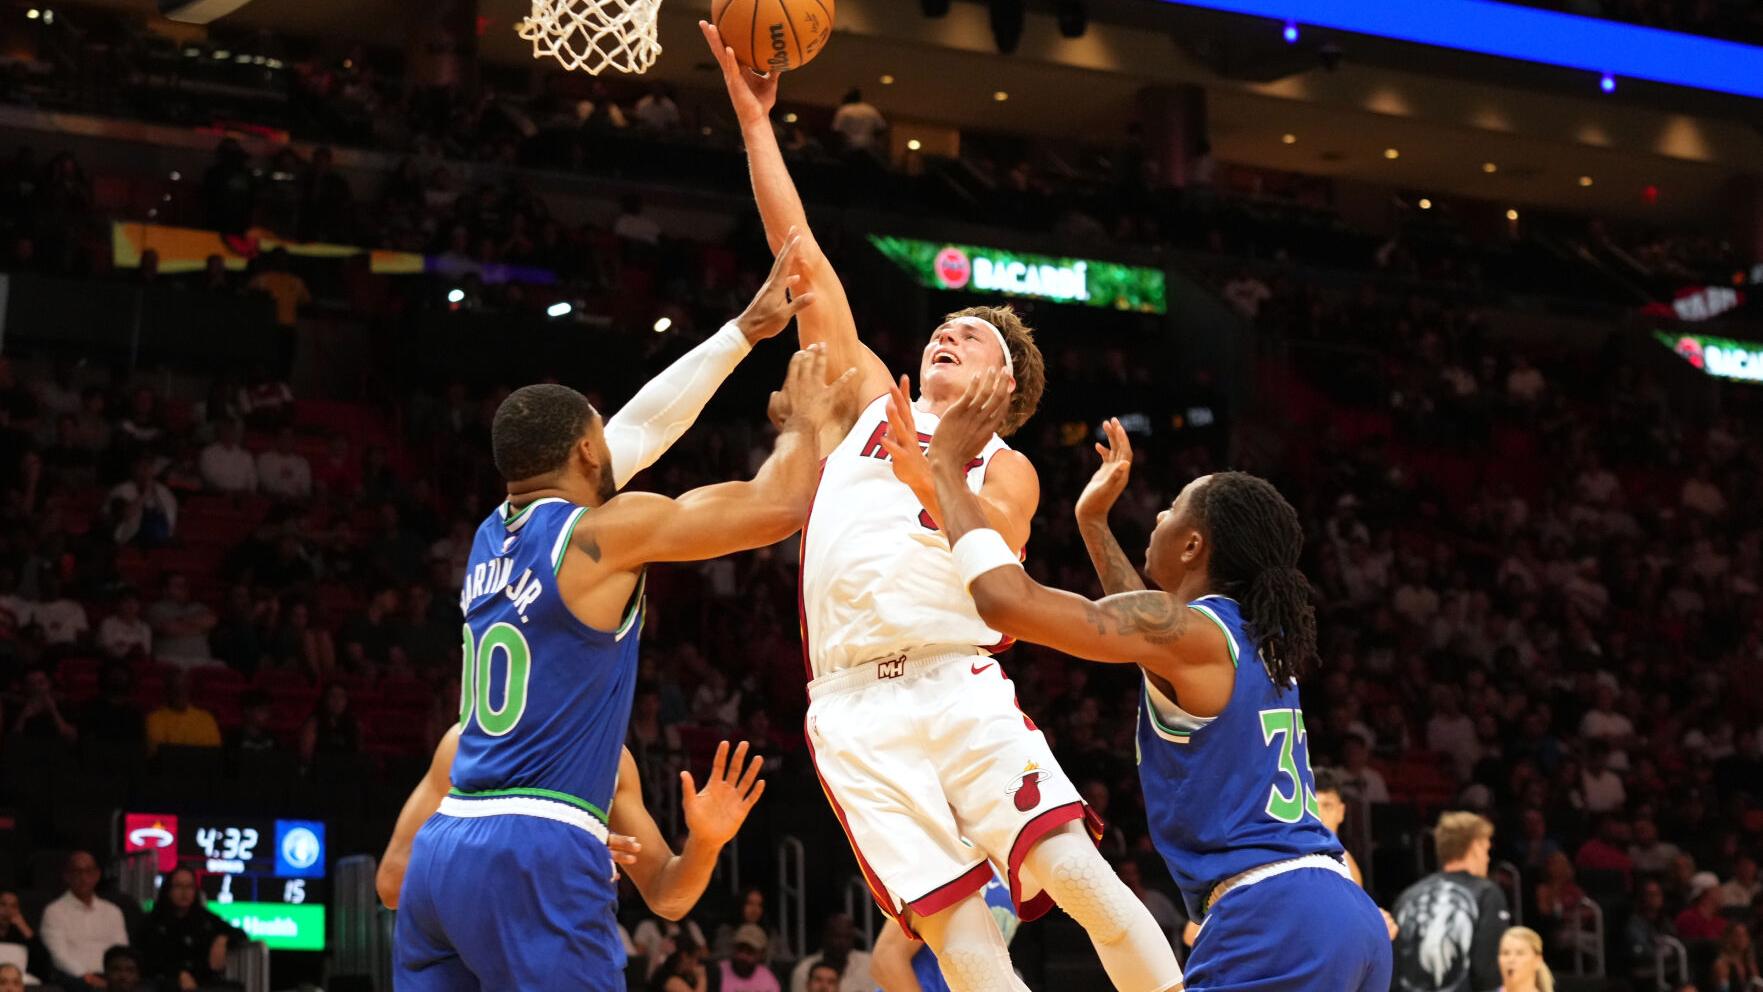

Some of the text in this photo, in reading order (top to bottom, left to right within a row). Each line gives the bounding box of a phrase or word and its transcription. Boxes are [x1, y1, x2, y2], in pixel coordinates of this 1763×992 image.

[767, 23, 789, 71] lson
[1704, 345, 1763, 380] BACA
[505, 567, 543, 624] JR.
[196, 828, 258, 860] 4:32
[283, 879, 305, 904] 15
